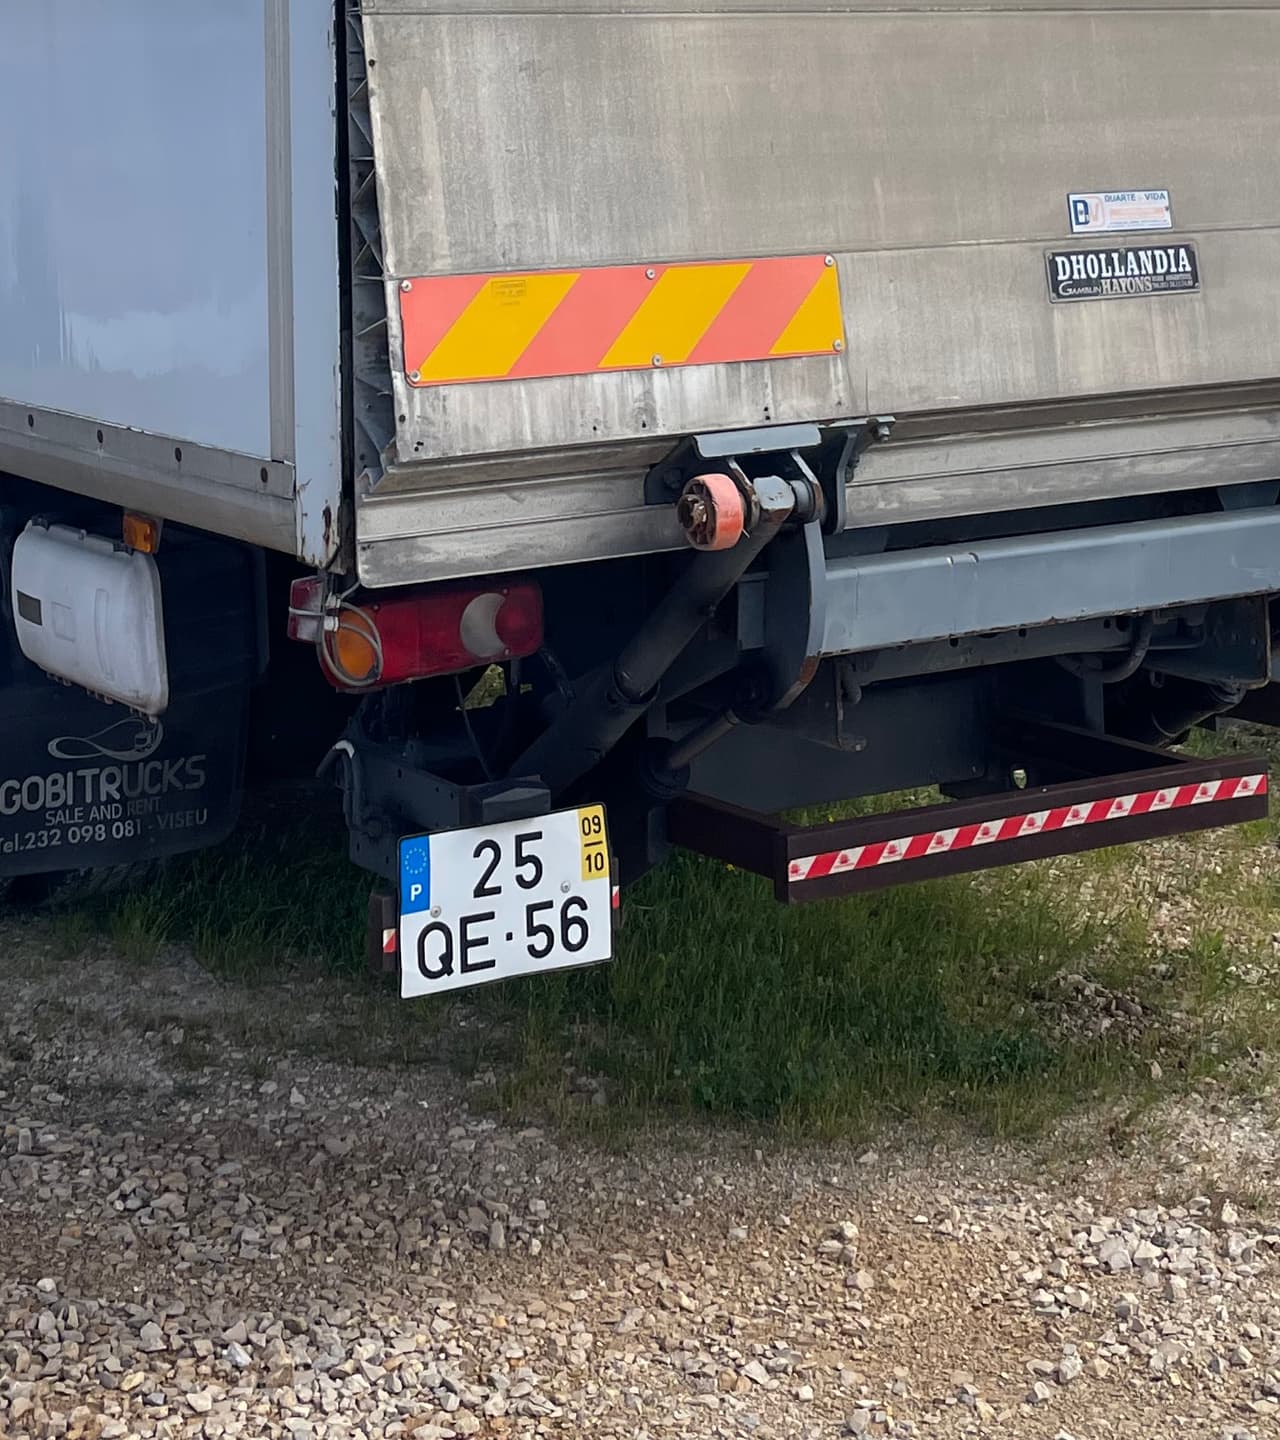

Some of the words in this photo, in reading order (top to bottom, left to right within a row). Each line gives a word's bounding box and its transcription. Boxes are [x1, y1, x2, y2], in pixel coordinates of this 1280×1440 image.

[1104, 193, 1136, 202] DUARTE
[1144, 192, 1166, 201] VIDA
[1054, 248, 1192, 281] DHOLLANDIA
[1101, 276, 1153, 295] HAYONS
[45, 806, 84, 826] SALE
[89, 803, 122, 822] AND
[127, 796, 161, 817] RENT
[68, 823, 106, 844] 098
[112, 818, 141, 838] 081
[156, 807, 208, 830] VISEU
[581, 815, 602, 836] 09
[472, 831, 544, 898] 25
[584, 852, 605, 873] 10
[410, 883, 423, 902] P
